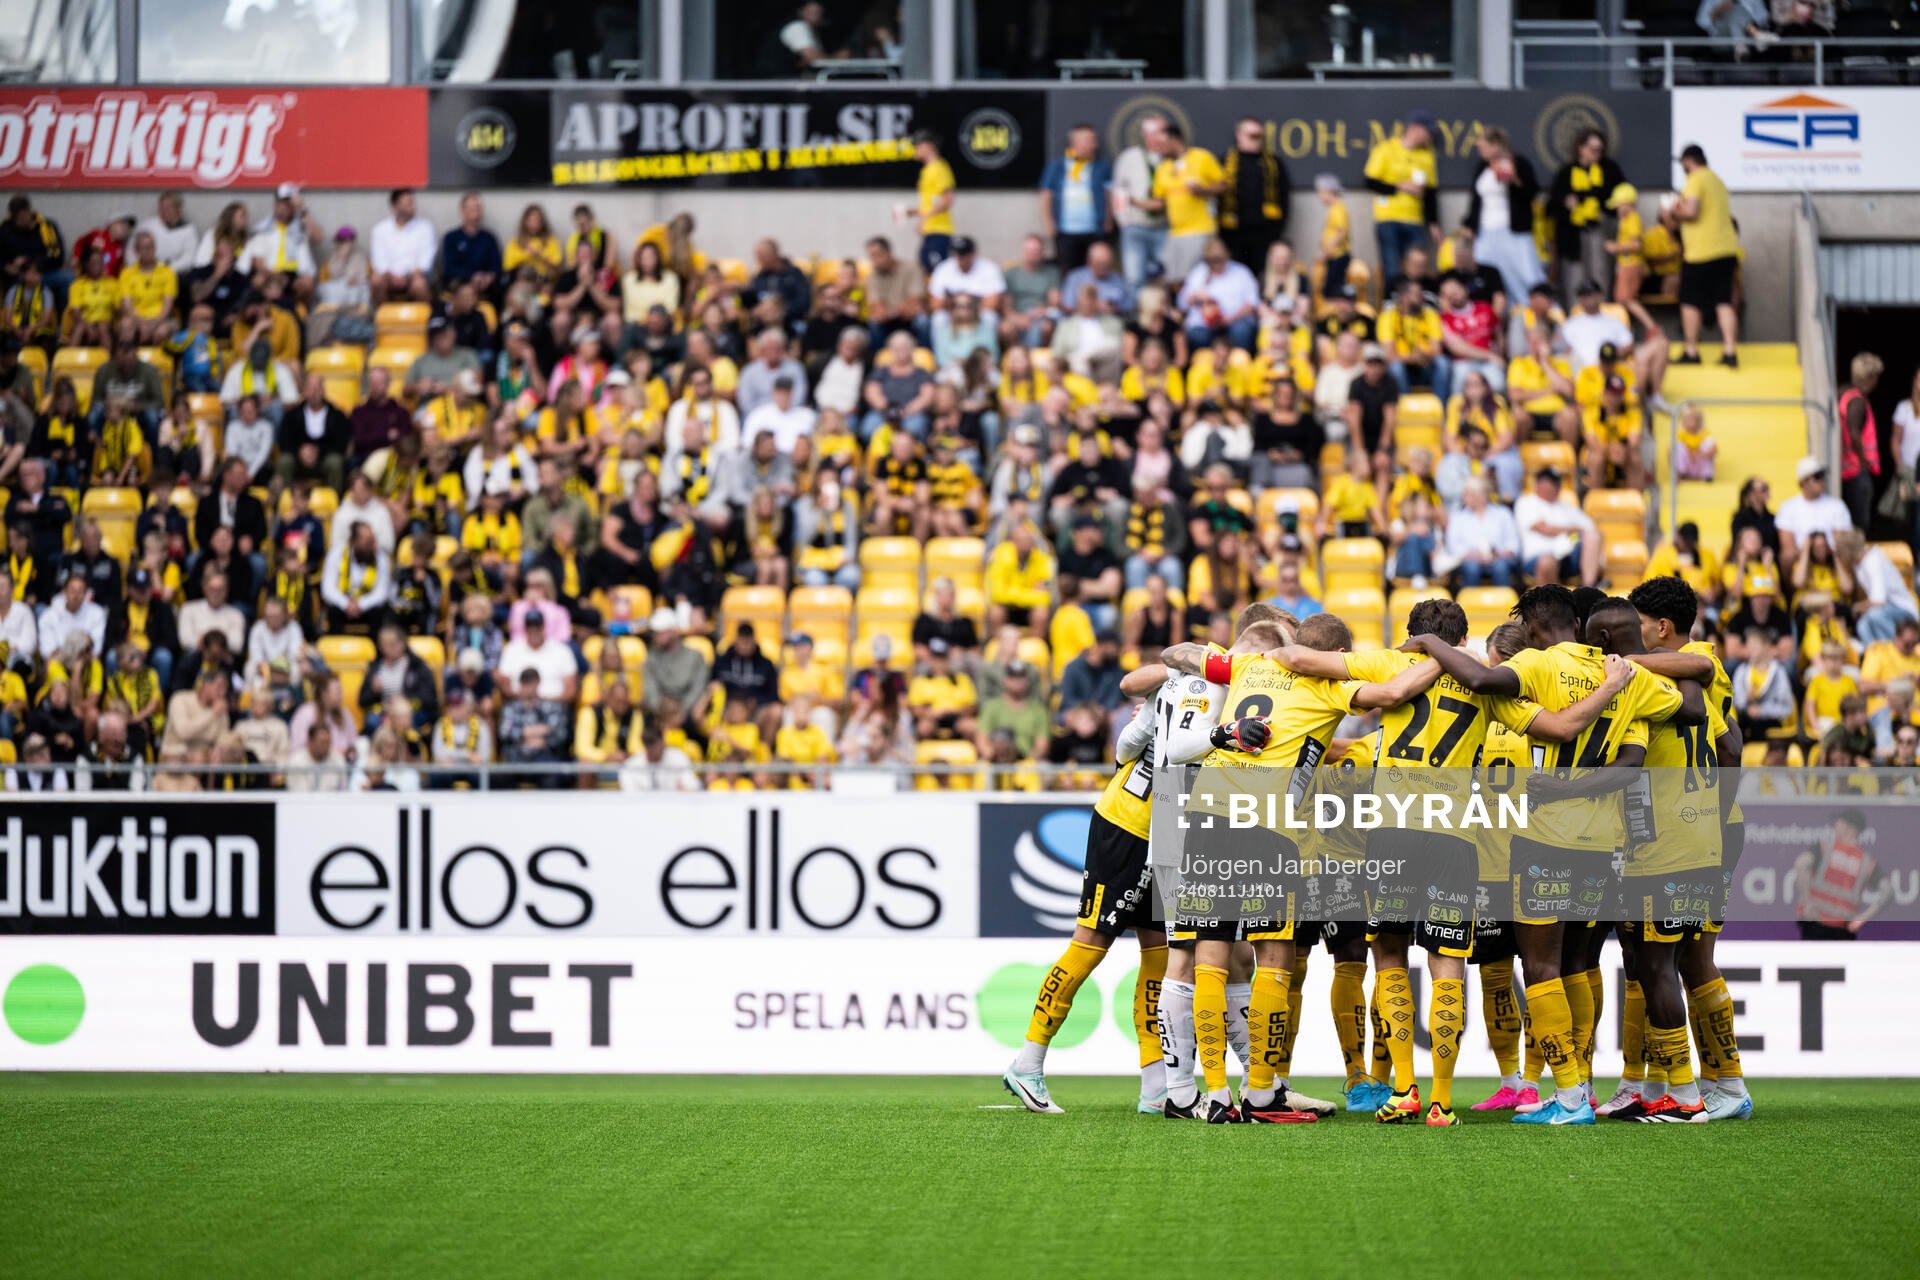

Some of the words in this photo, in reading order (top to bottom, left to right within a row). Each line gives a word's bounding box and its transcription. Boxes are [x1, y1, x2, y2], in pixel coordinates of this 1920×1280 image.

[555, 101, 914, 151] APROFIL.SE
[1264, 118, 1487, 158] OH-MYA
[1388, 692, 1480, 768] 27
[1293, 742, 1321, 793] input
[1434, 781, 1458, 793] GROUP
[310, 807, 595, 930] ellos
[660, 808, 943, 931] ellos
[1538, 883, 1569, 896] EAB
[1180, 897, 1210, 911] EAB
[1429, 906, 1461, 924] EAB
[1527, 898, 1571, 911] Cerner
[1106, 911, 1117, 926] 4
[1324, 921, 1339, 938] 10
[192, 961, 633, 1048] UNIBET
[734, 991, 866, 1029] SPELA
[884, 991, 968, 1030] ANS
